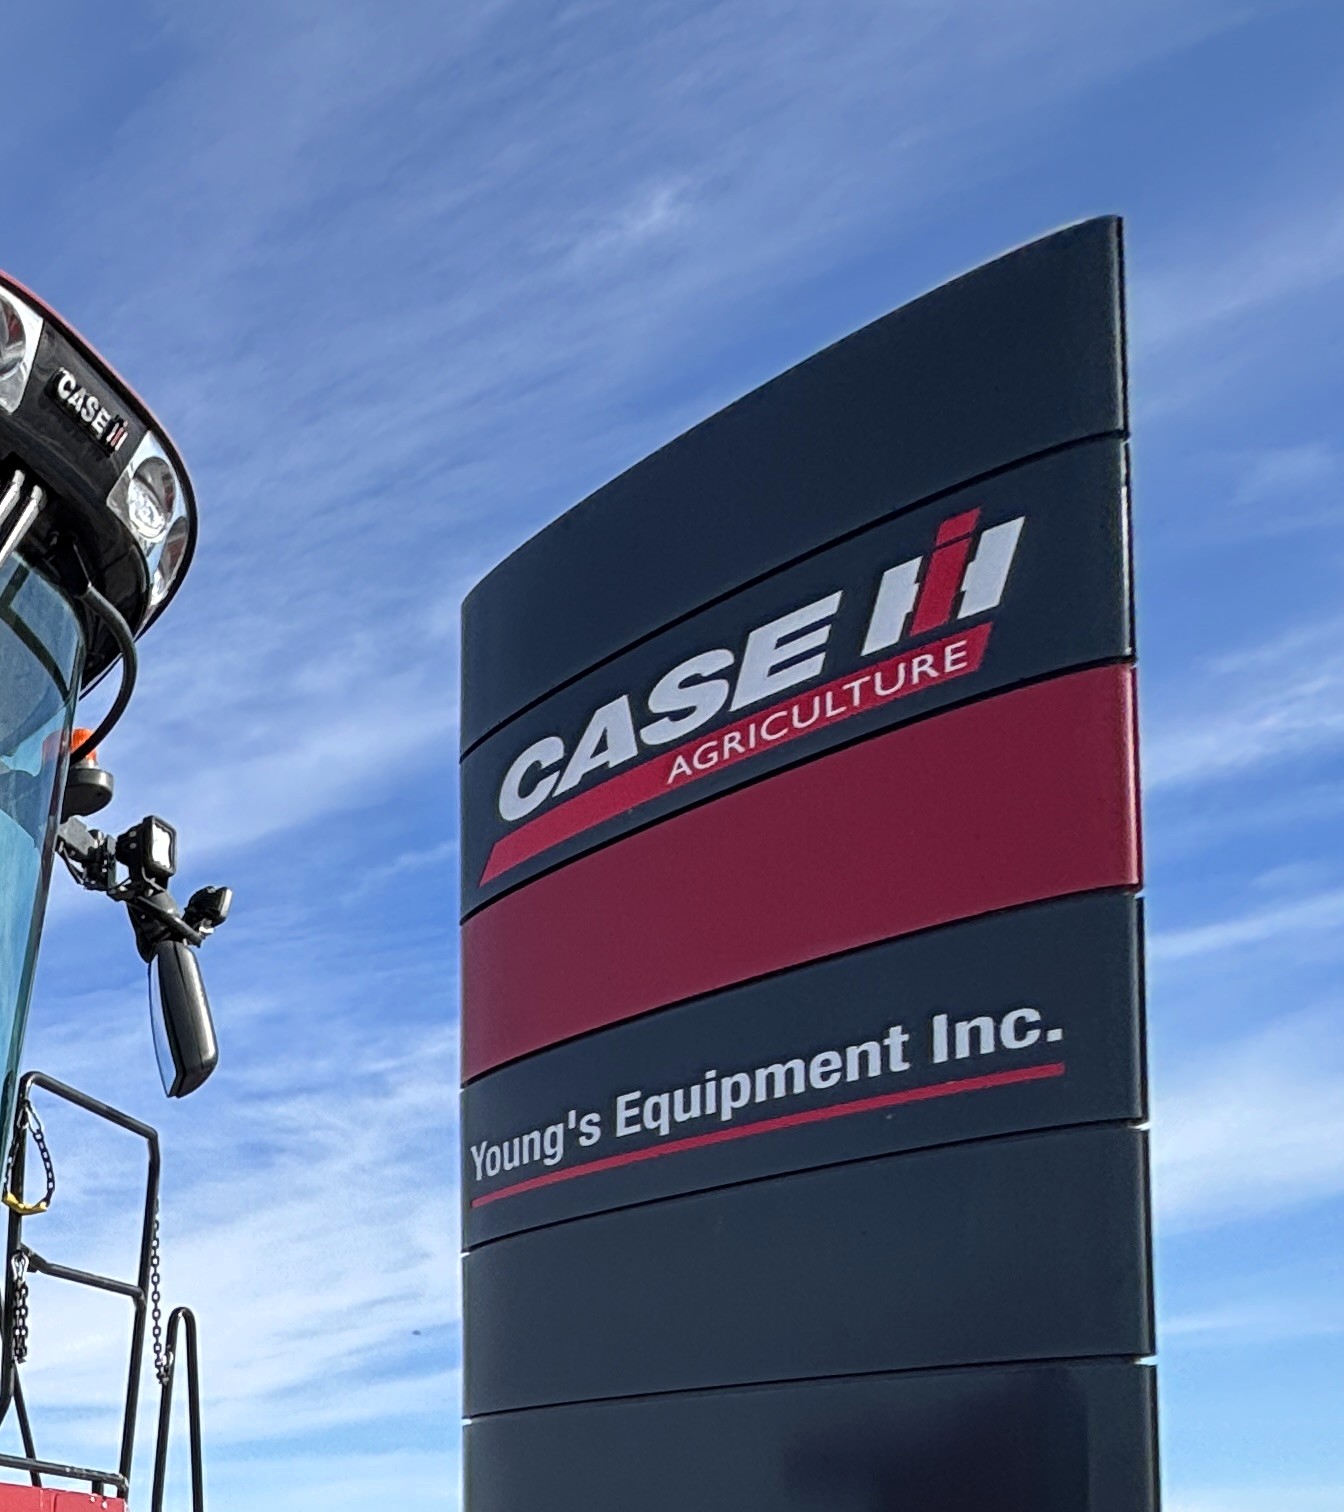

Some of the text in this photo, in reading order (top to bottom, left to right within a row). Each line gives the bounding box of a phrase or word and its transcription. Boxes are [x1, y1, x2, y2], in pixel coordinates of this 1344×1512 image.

[58, 369, 111, 438] CASE
[498, 590, 843, 822] CASE
[667, 640, 968, 784] AGRICULTURE
[470, 1005, 1064, 1181] Young's Equipment Inc.
